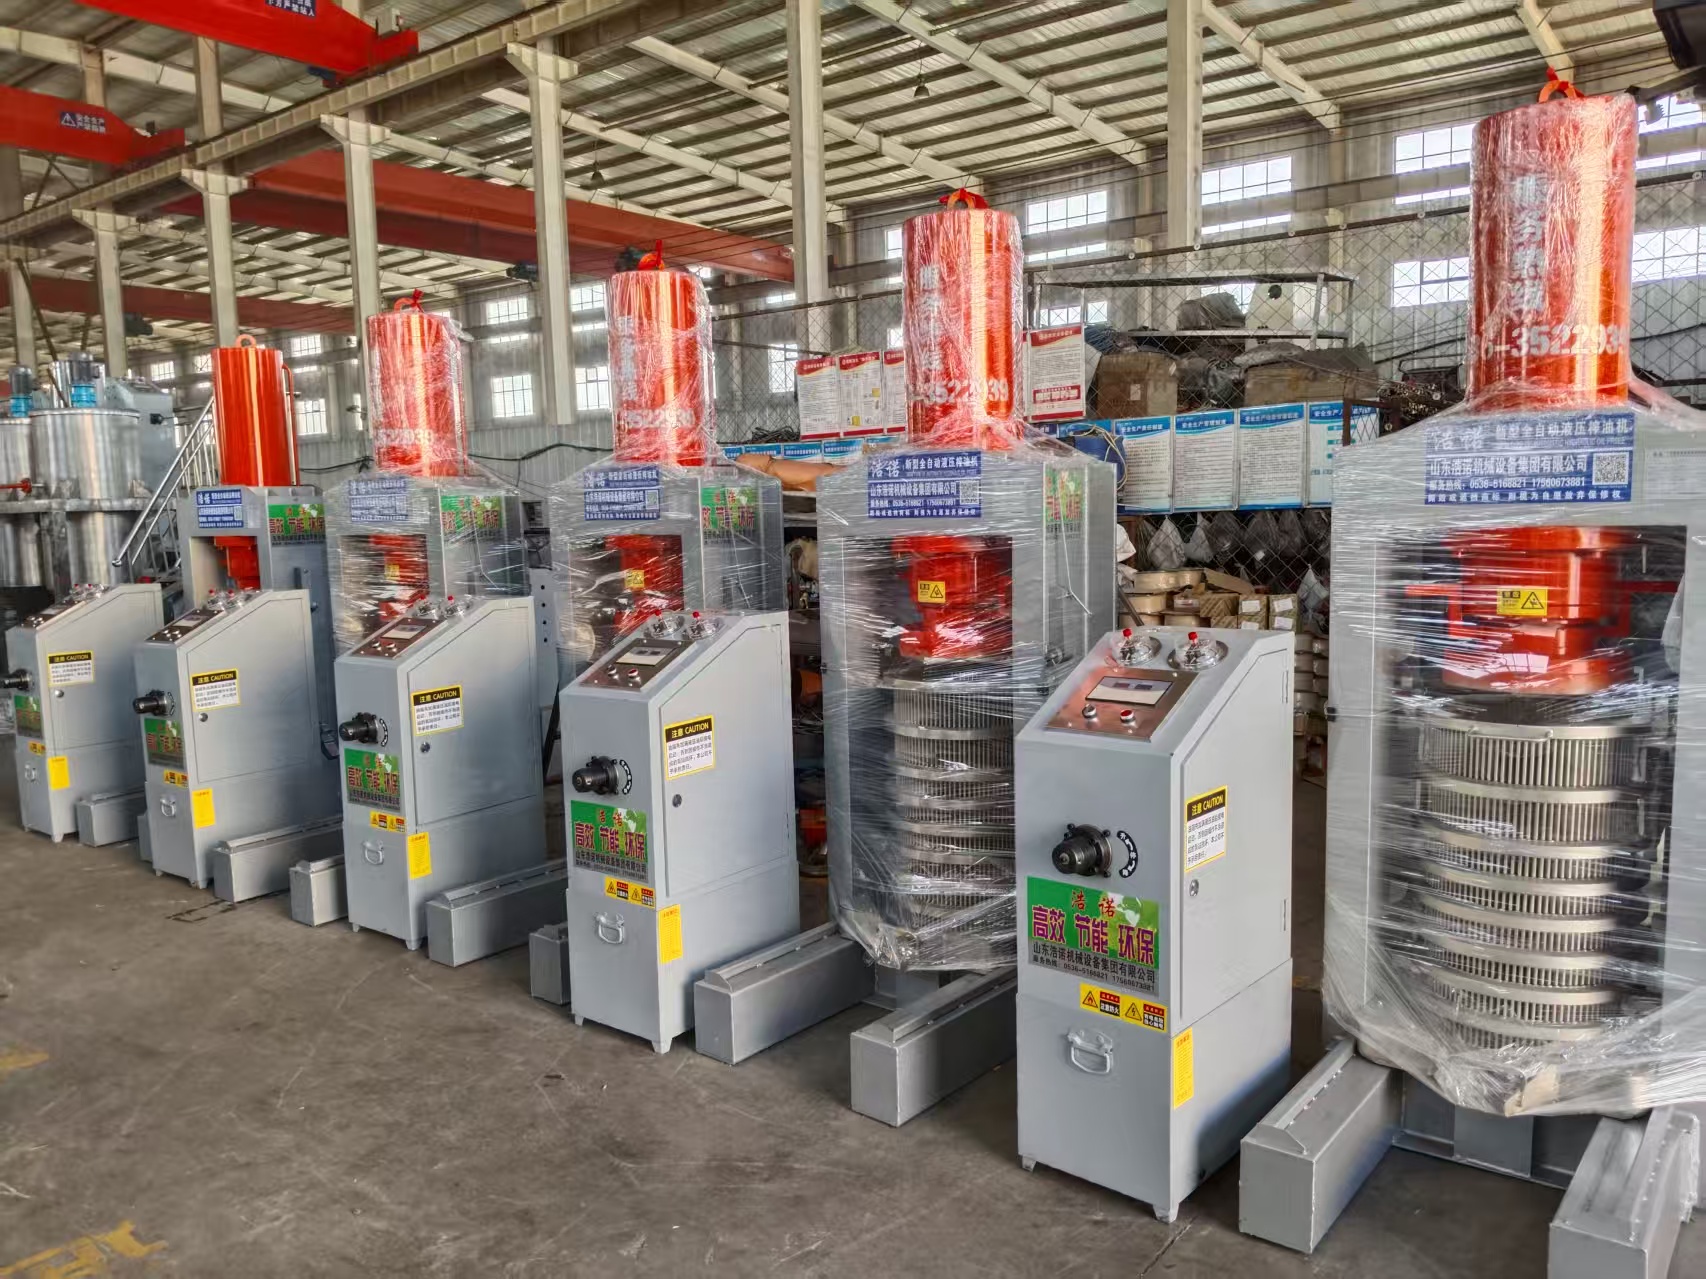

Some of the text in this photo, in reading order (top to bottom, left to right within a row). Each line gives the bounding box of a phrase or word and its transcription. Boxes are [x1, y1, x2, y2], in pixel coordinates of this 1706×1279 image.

[66, 653, 89, 661] CAUTION
[210, 672, 234, 682] CAUTION
[433, 690, 457, 700] CAUTION
[684, 721, 709, 735] CAUTION
[1203, 795, 1224, 811] CAUTION
[575, 821, 645, 861] 高效 节能 环保
[1032, 904, 1155, 966] 高效 节能 环保
